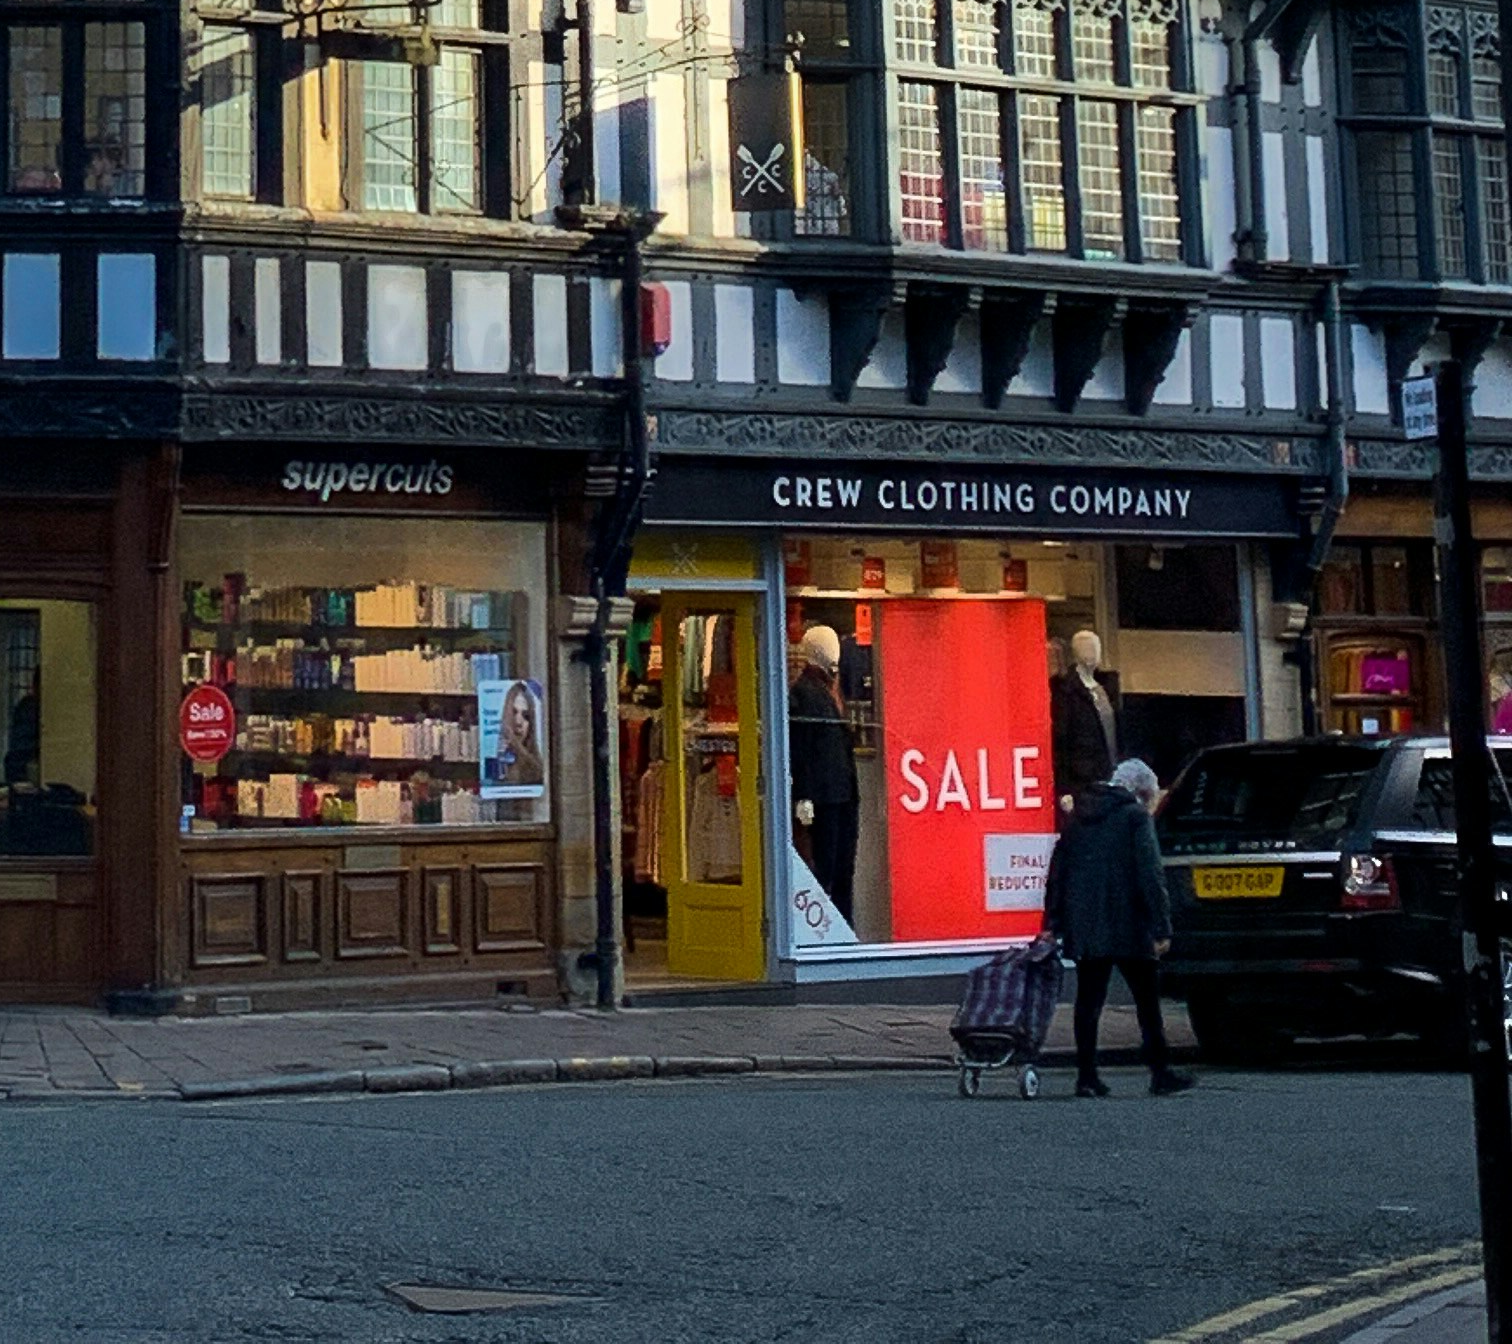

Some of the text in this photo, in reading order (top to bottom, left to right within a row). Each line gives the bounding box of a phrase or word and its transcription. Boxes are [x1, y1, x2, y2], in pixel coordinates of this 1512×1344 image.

[281, 459, 454, 502] supercuts
[772, 476, 1191, 519] CREW CLOTHING COMPANY
[189, 703, 225, 722] Sale
[899, 746, 1043, 813] SALE
[1010, 854, 1047, 869] FINAL
[989, 875, 1048, 890] REDUCTI
